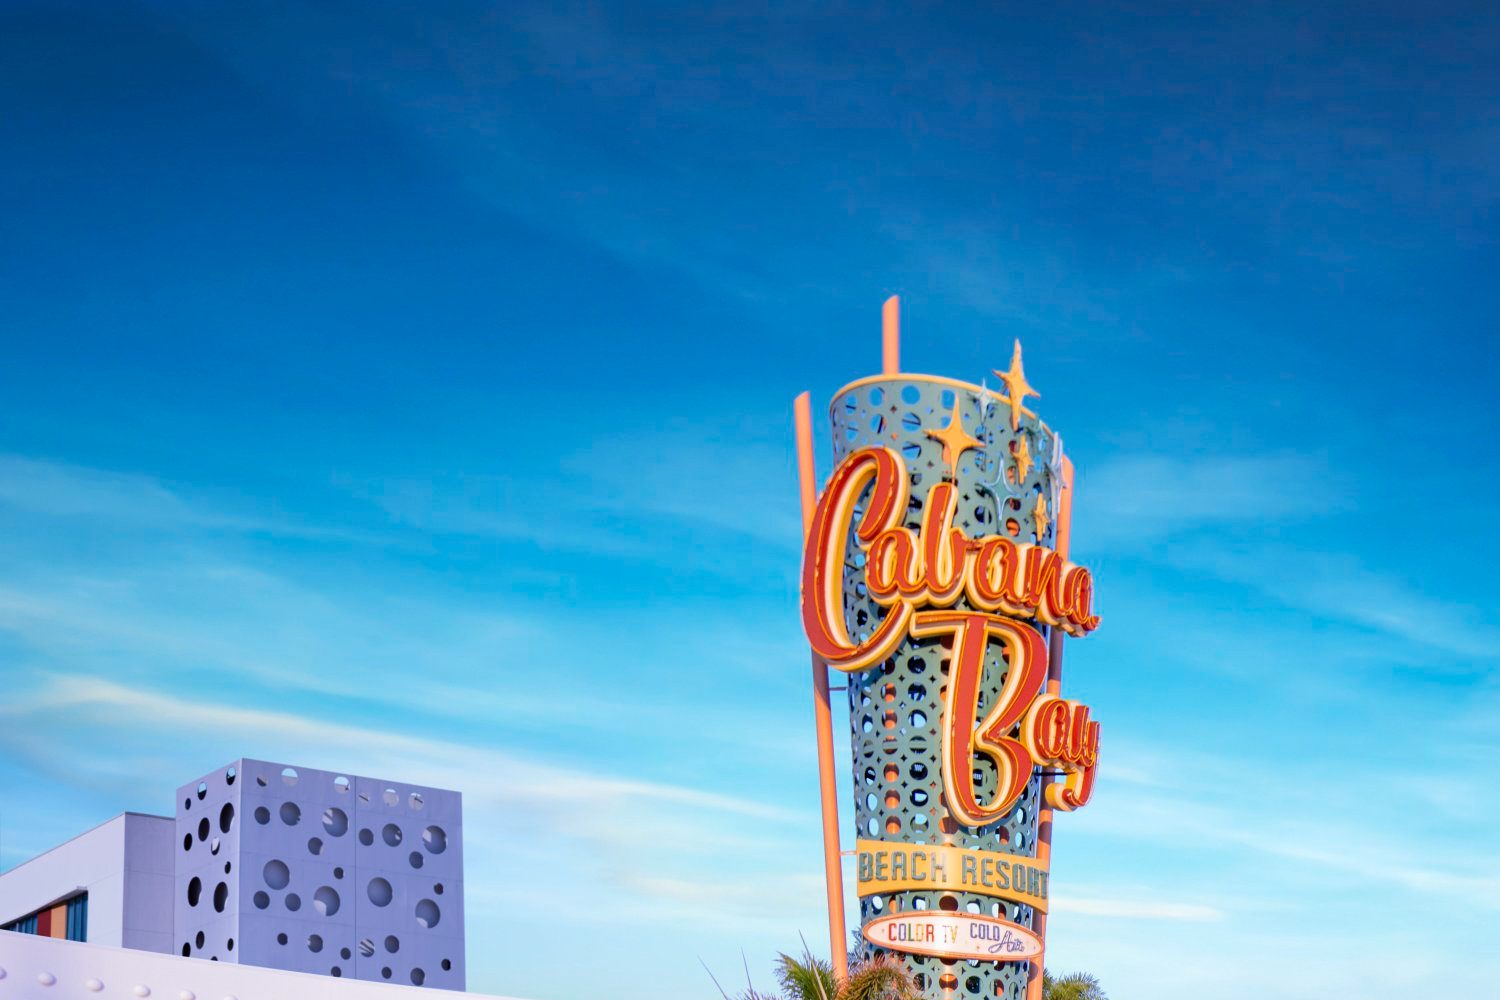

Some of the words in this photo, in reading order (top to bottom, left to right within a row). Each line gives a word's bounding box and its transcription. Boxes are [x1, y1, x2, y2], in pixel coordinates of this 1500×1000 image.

[801, 446, 1102, 672] Cabana
[909, 610, 1101, 827] Bay
[858, 851, 947, 882] BEACH
[961, 854, 1049, 899] RESORT
[888, 922, 935, 943] COLOR
[942, 924, 959, 944] TV
[970, 922, 1000, 941] COLD
